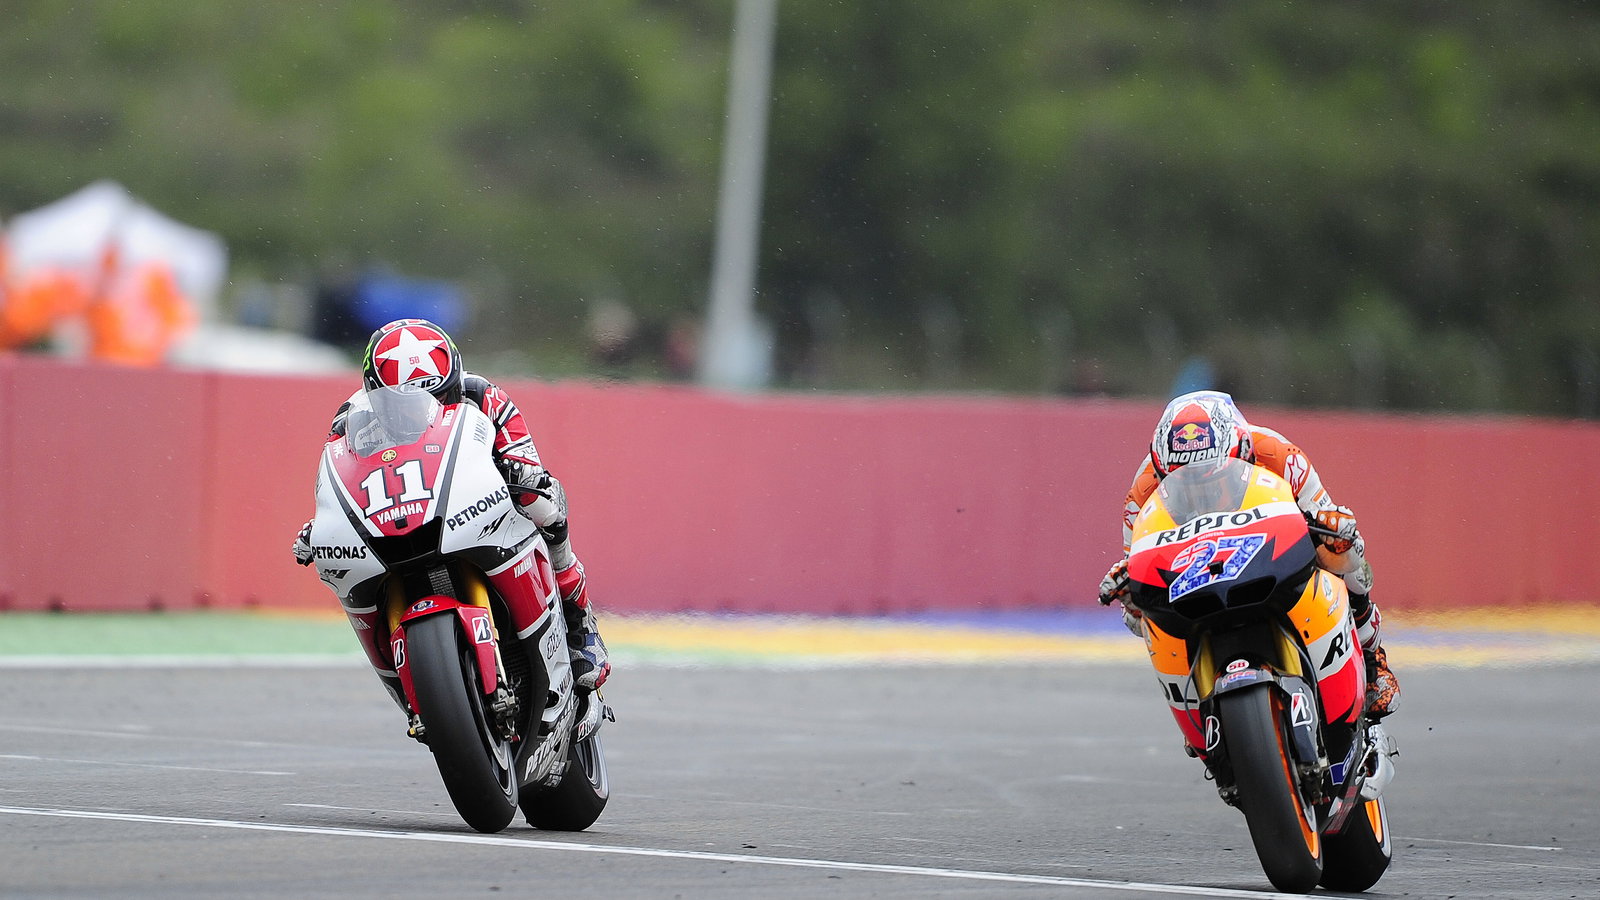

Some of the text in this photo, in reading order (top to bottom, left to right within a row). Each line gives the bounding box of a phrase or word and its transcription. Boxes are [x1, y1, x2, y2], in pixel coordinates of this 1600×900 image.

[408, 355, 420, 365] 58
[1173, 437, 1211, 452] Red Bull
[1168, 448, 1220, 464] NOLAN
[360, 459, 434, 519] 11
[376, 502, 424, 525] YAMAHA
[446, 486, 509, 531] PETRONAS
[1155, 507, 1268, 546] REPSOL
[311, 545, 367, 560] PETRONAS
[1169, 533, 1267, 603] 27
[1229, 661, 1246, 670] 58
